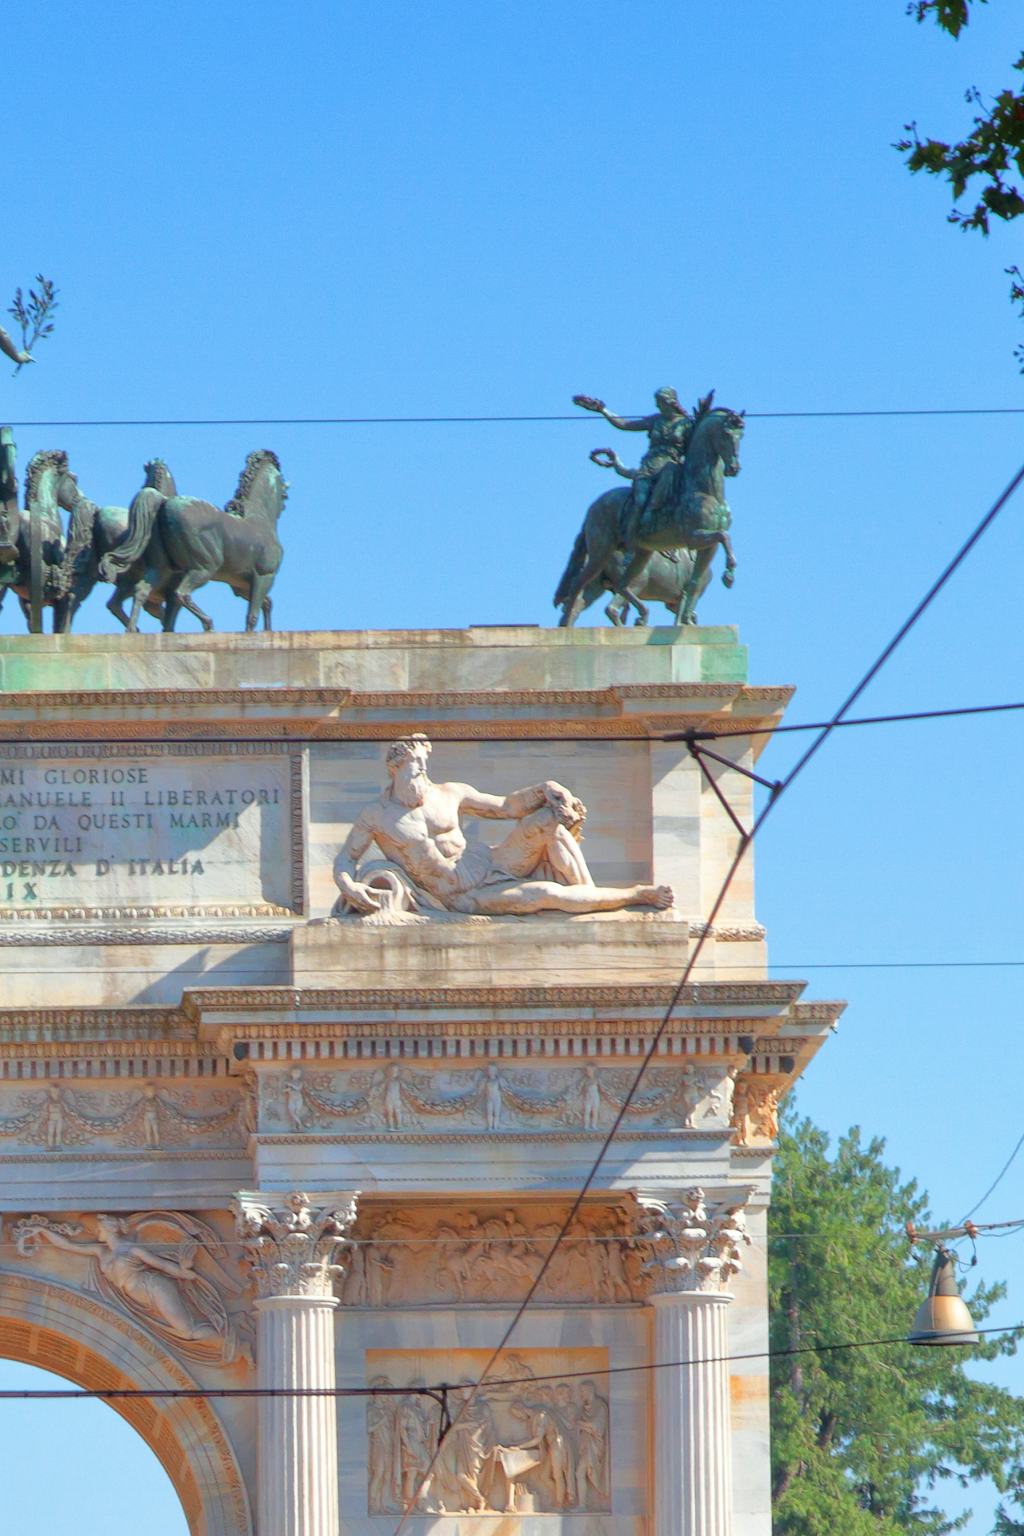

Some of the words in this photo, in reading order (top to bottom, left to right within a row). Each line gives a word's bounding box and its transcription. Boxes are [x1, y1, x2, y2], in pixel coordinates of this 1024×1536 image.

[44, 768, 148, 785] GLORIOSE
[111, 791, 125, 807] II
[144, 789, 279, 806] LIBERATORI
[33, 814, 60, 831] DA
[78, 813, 153, 830] QUESTI
[169, 811, 240, 829] MARMI
[0, 836, 83, 853] SERVILI
[127, 857, 206, 876] ITALIA
